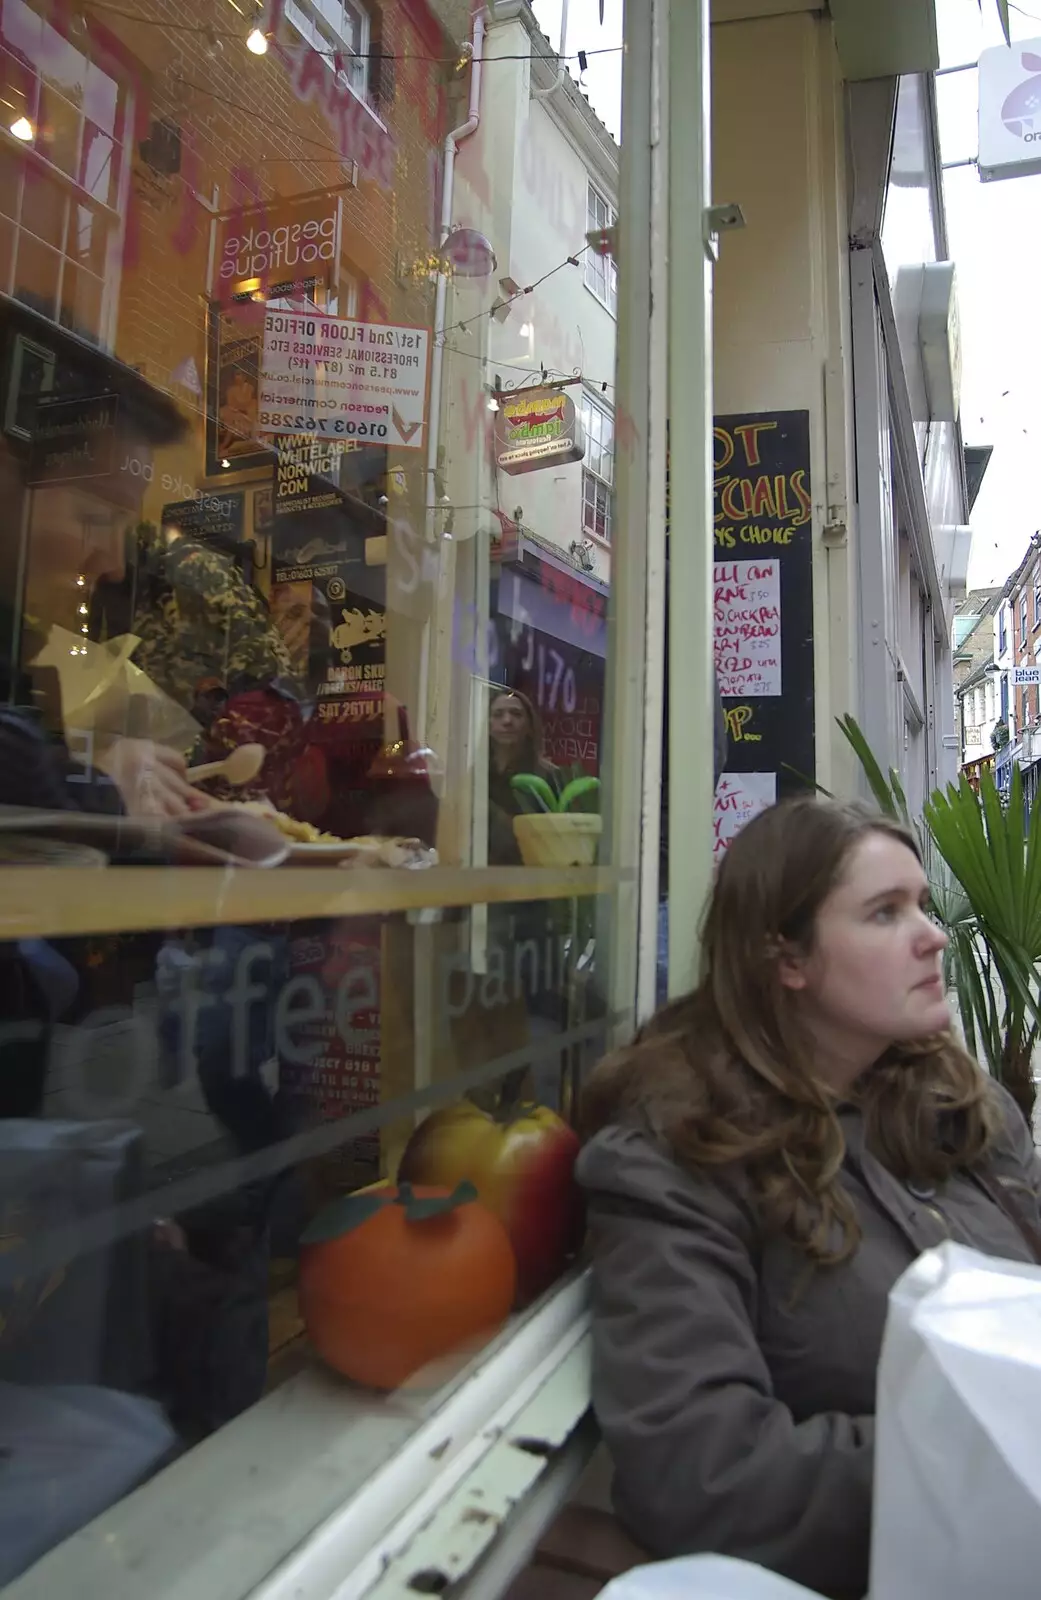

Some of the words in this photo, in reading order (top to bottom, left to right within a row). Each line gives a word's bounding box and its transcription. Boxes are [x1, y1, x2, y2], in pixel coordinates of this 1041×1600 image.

[277, 438, 363, 467] WHITELABEL
[277, 455, 341, 482] NORWICH
[276, 478, 308, 497] .COM
[1014, 669, 1040, 677] blue
